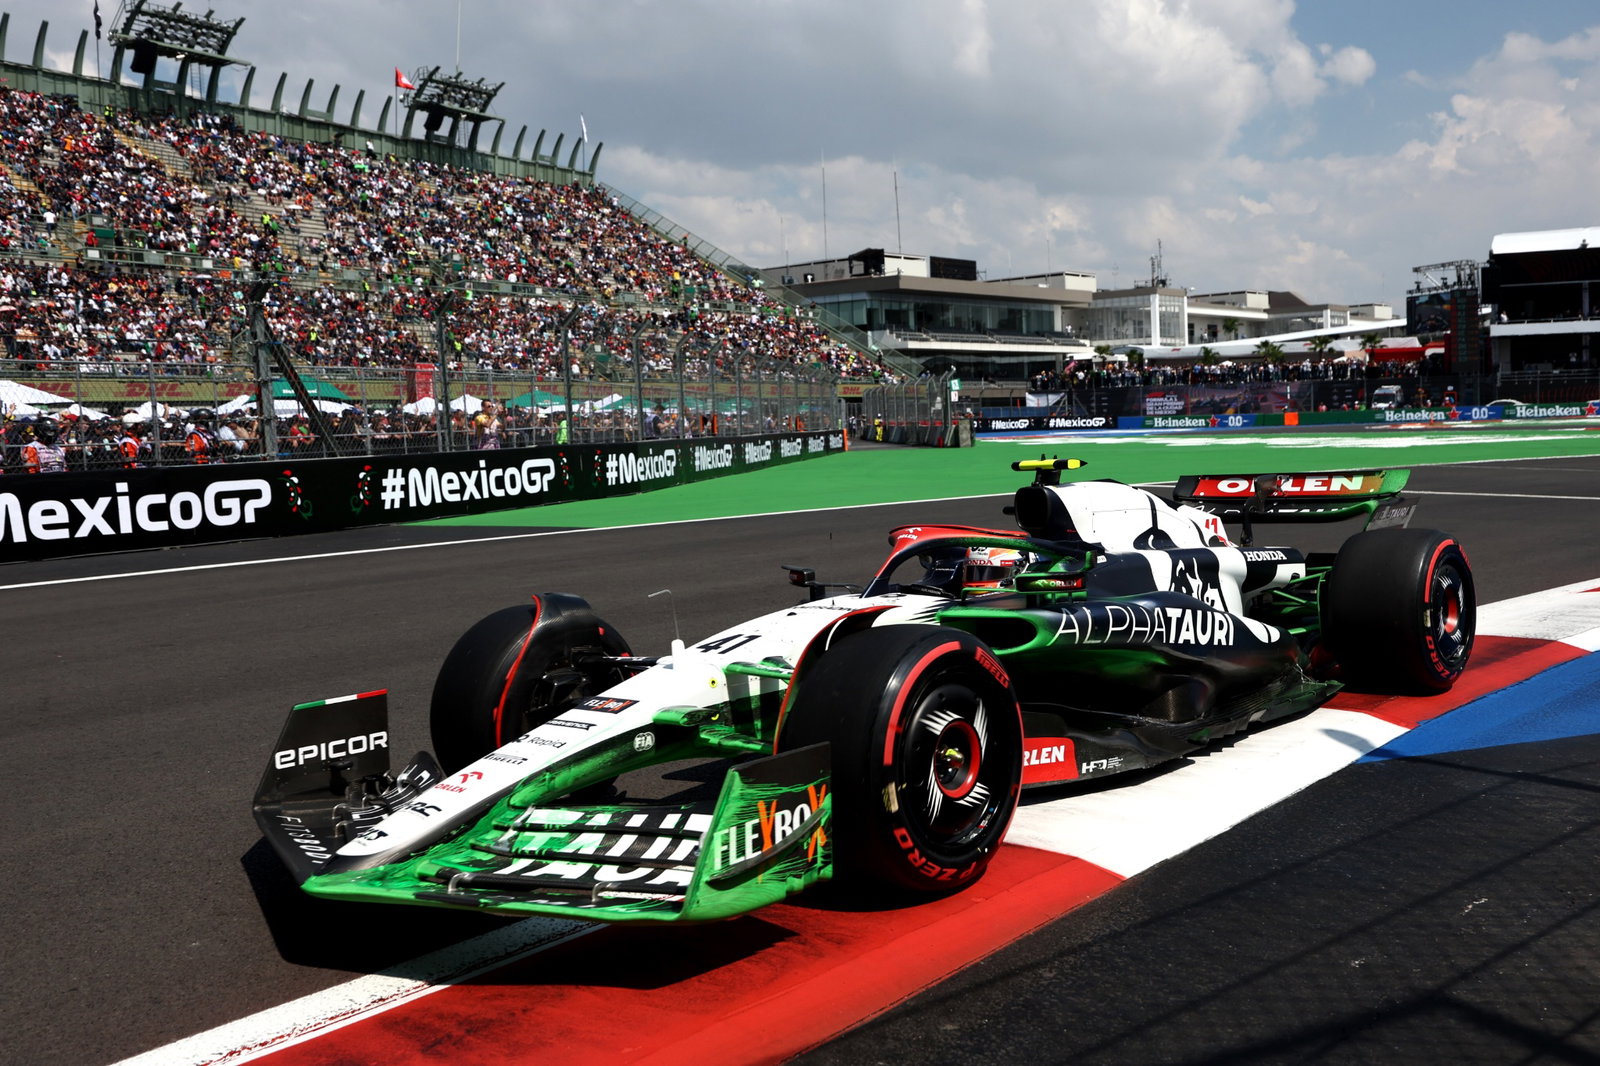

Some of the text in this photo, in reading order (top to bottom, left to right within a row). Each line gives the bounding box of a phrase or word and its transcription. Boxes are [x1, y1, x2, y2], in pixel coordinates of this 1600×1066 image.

[1385, 410, 1445, 422] Heineken
[1516, 403, 1581, 418] Heineken
[991, 419, 1029, 430] #MexicoGP
[1049, 417, 1105, 428] #MexicoGP
[1153, 417, 1206, 428] Heineken
[694, 443, 733, 472] #MexicoGP
[745, 440, 772, 464] #MexicoGP
[780, 437, 802, 458] #MexicoGP
[605, 448, 677, 485] #MexicoGP
[381, 458, 556, 510] #MexicoGP
[1243, 550, 1288, 562] HONDA
[1050, 580, 1077, 588] ORLEN
[1047, 607, 1234, 646] ALPHATAURI
[696, 634, 762, 655] 41
[975, 646, 1010, 688] PIRELLI
[484, 753, 528, 765] PIRELLI
[1023, 745, 1065, 767] RLEN
[434, 783, 468, 794] ORLEN
[893, 827, 957, 880] ZERO
